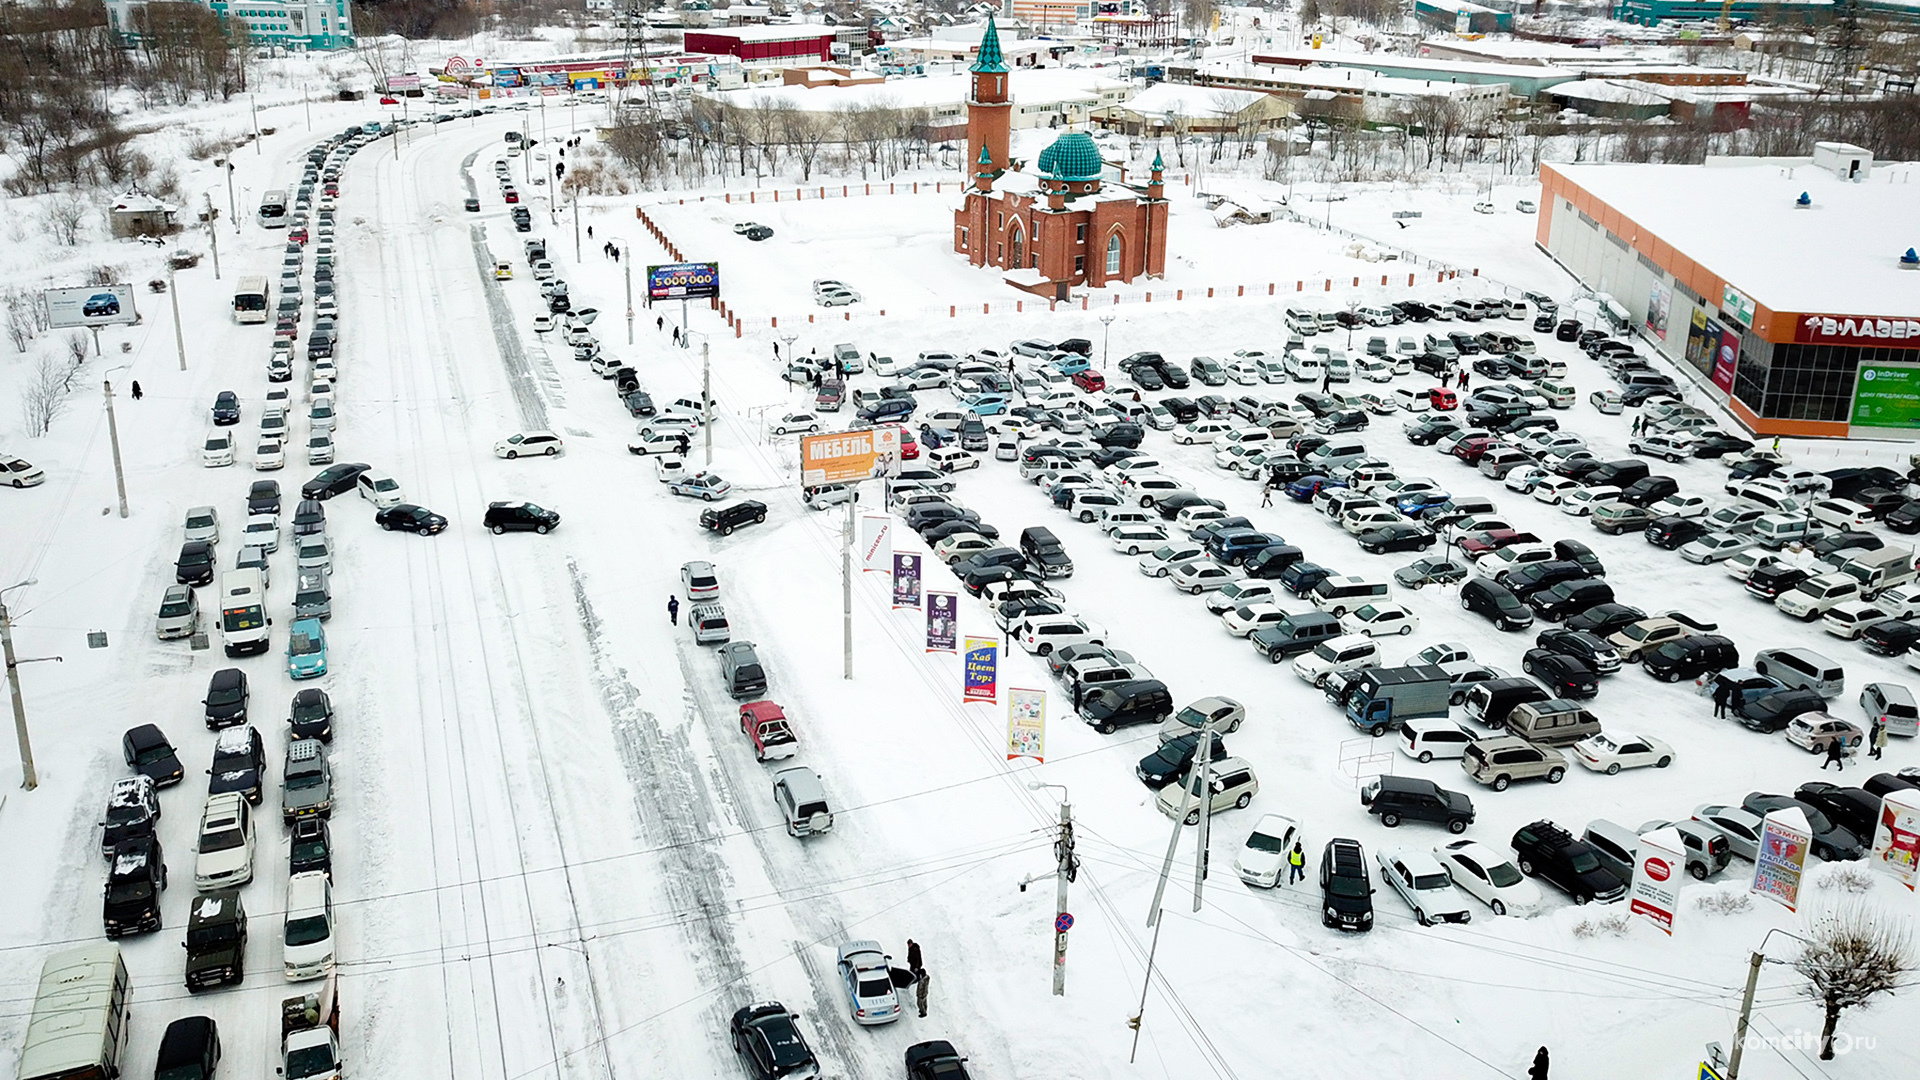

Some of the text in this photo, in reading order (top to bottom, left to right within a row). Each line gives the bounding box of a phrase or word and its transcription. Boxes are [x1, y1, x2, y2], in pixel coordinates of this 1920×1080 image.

[655, 275, 712, 286] 5 000 000
[1877, 370, 1909, 378] inDriver
[810, 437, 872, 461] МЕБЕЛЬ
[865, 525, 889, 562] minicen.ru
[972, 652, 991, 662] Хаб
[967, 662, 995, 672] Цвет
[970, 672, 993, 683] Торг
[1761, 852, 1801, 872] ПАЛЛАДА
[1636, 889, 1656, 900] ЧЕРЕЗ
